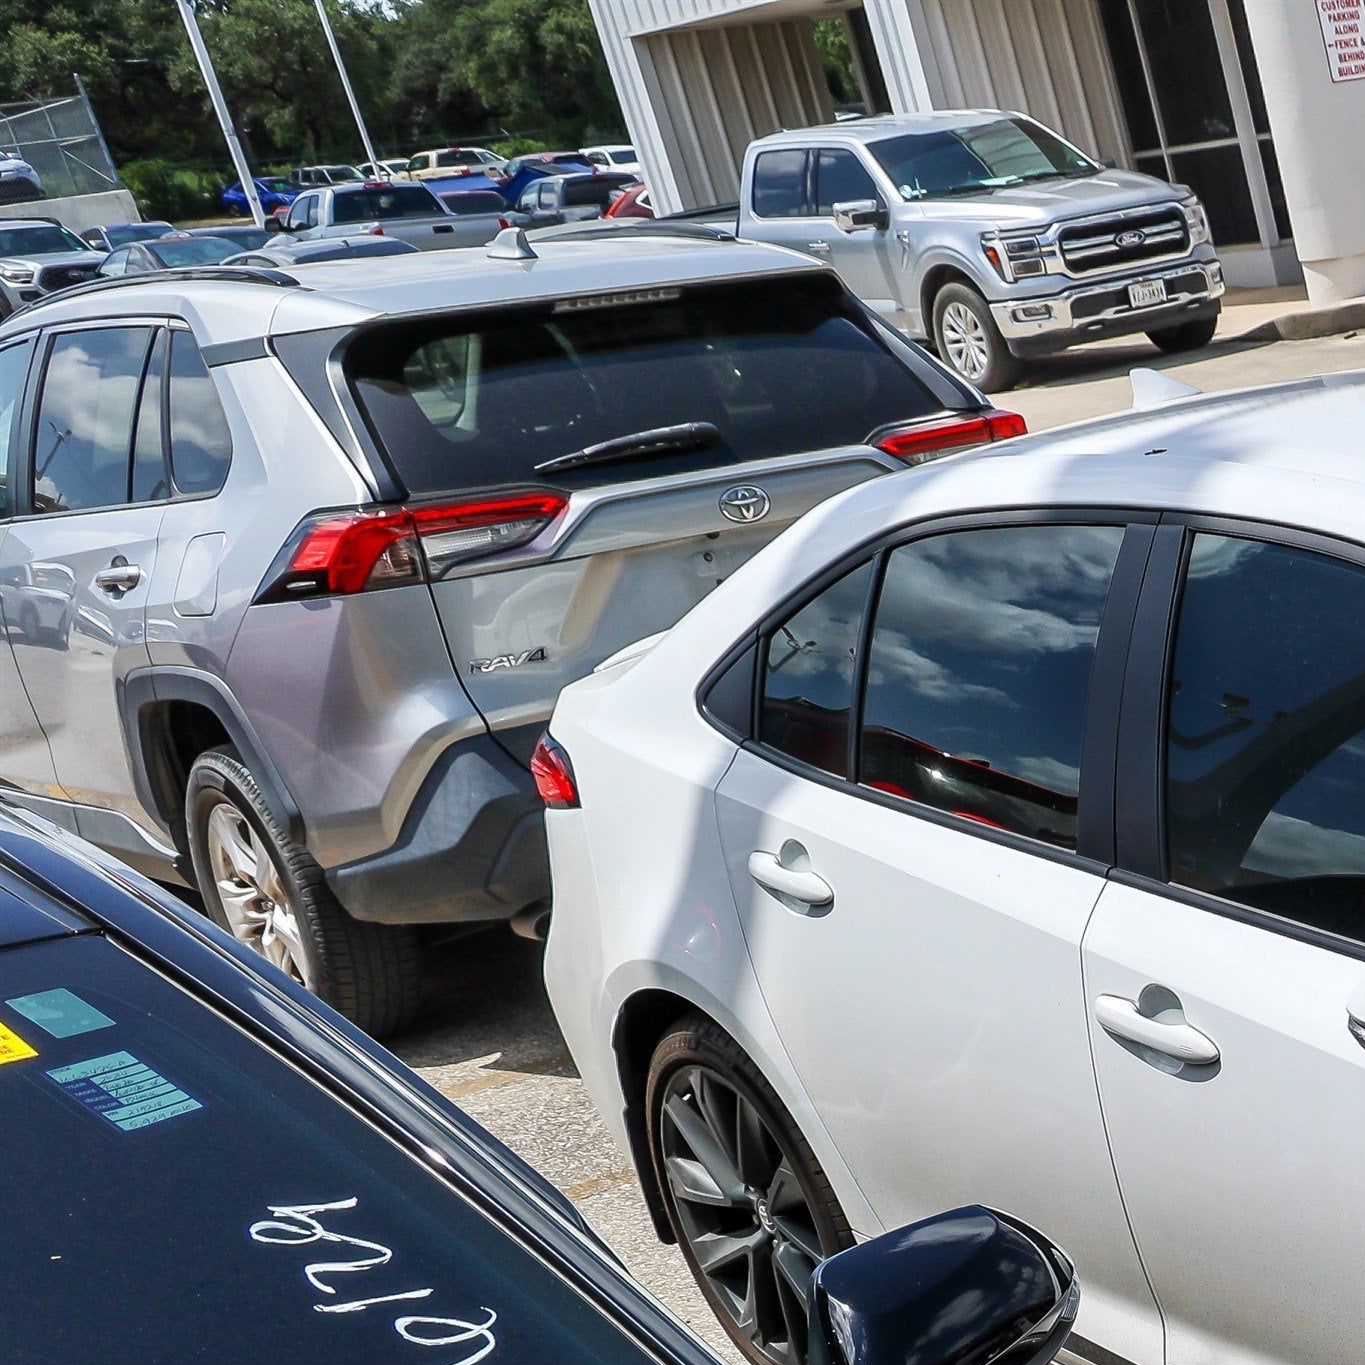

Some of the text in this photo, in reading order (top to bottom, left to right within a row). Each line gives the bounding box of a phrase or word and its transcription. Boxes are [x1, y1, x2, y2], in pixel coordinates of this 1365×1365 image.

[1321, 0, 1361, 11] CUSTOMER
[1328, 10, 1360, 23] PARKING
[1335, 24, 1359, 35] ALONG
[1335, 38, 1358, 50] FENCE
[1338, 51, 1365, 63] BEHIND
[468, 646, 548, 675] RAV4
